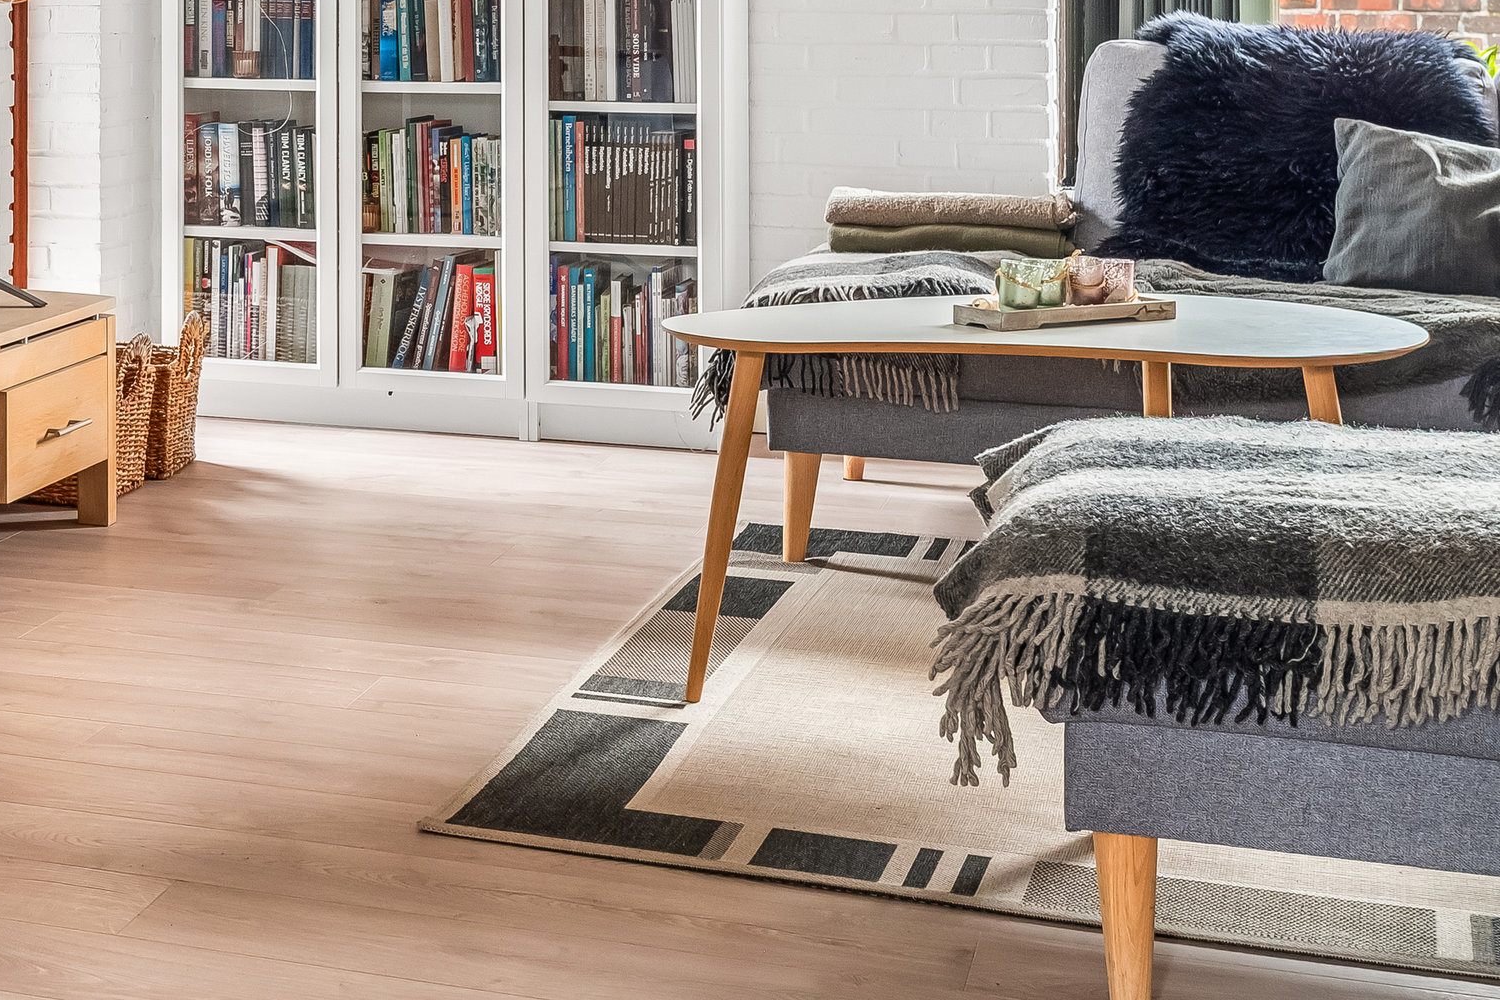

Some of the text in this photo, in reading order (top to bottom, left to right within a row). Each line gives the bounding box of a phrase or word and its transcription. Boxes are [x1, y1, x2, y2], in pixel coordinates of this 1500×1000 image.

[632, 33, 640, 78] SOUS VIDE
[203, 135, 213, 198] JORDENS FOLK
[281, 132, 291, 181] TOM CLANCY
[297, 133, 306, 182] TOM CLANCY
[458, 274, 470, 353] ASCHEHOUGS STORE
[475, 282, 484, 308] NØGLE
[483, 282, 492, 345] STORE KRYDSORDS
[396, 286, 427, 361] LYSTFISKERBOG
